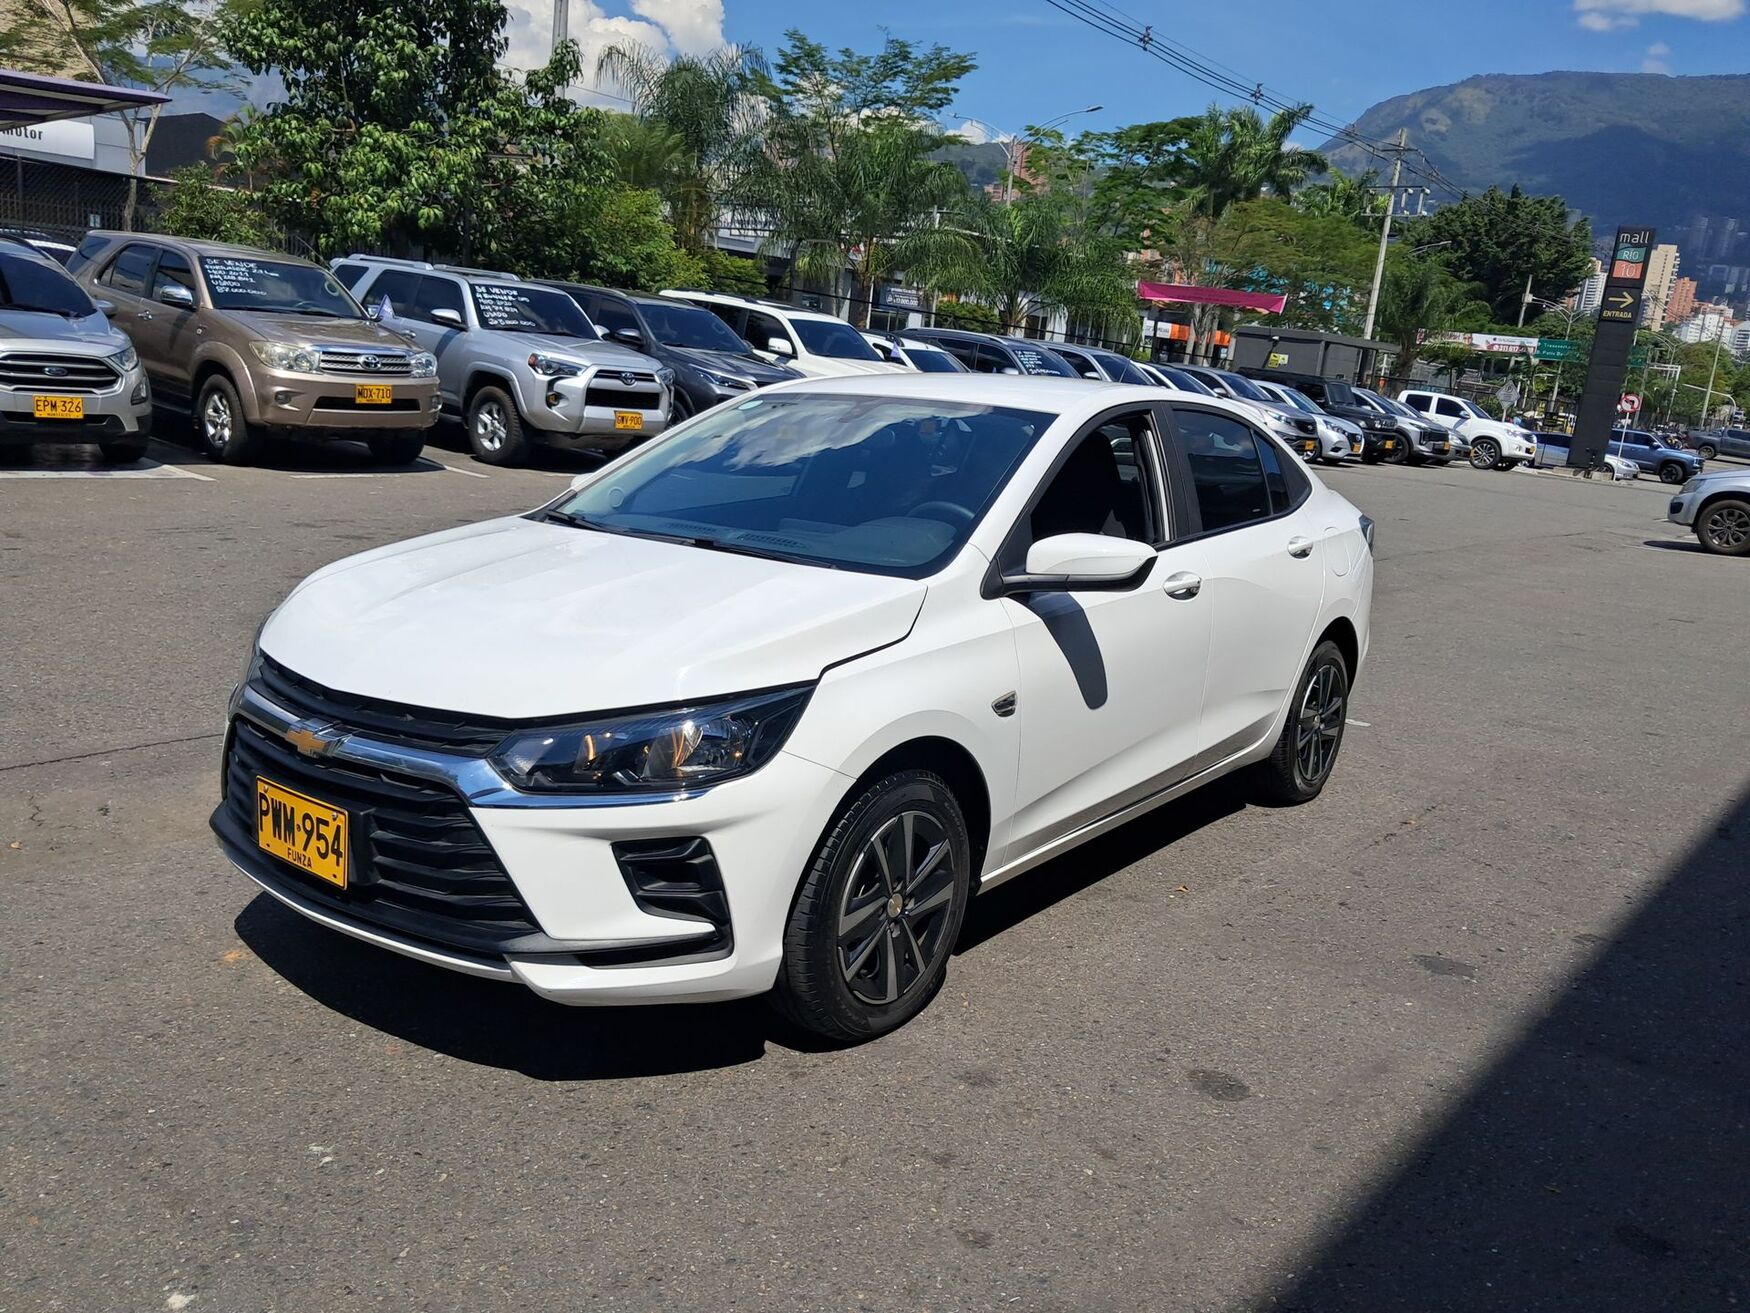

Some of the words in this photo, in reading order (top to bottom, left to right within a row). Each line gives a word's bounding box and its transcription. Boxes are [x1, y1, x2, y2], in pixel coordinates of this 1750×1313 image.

[1620, 231, 1650, 244] mall
[1602, 310, 1632, 319] ENTRADA
[287, 847, 313, 869] FUNZA
